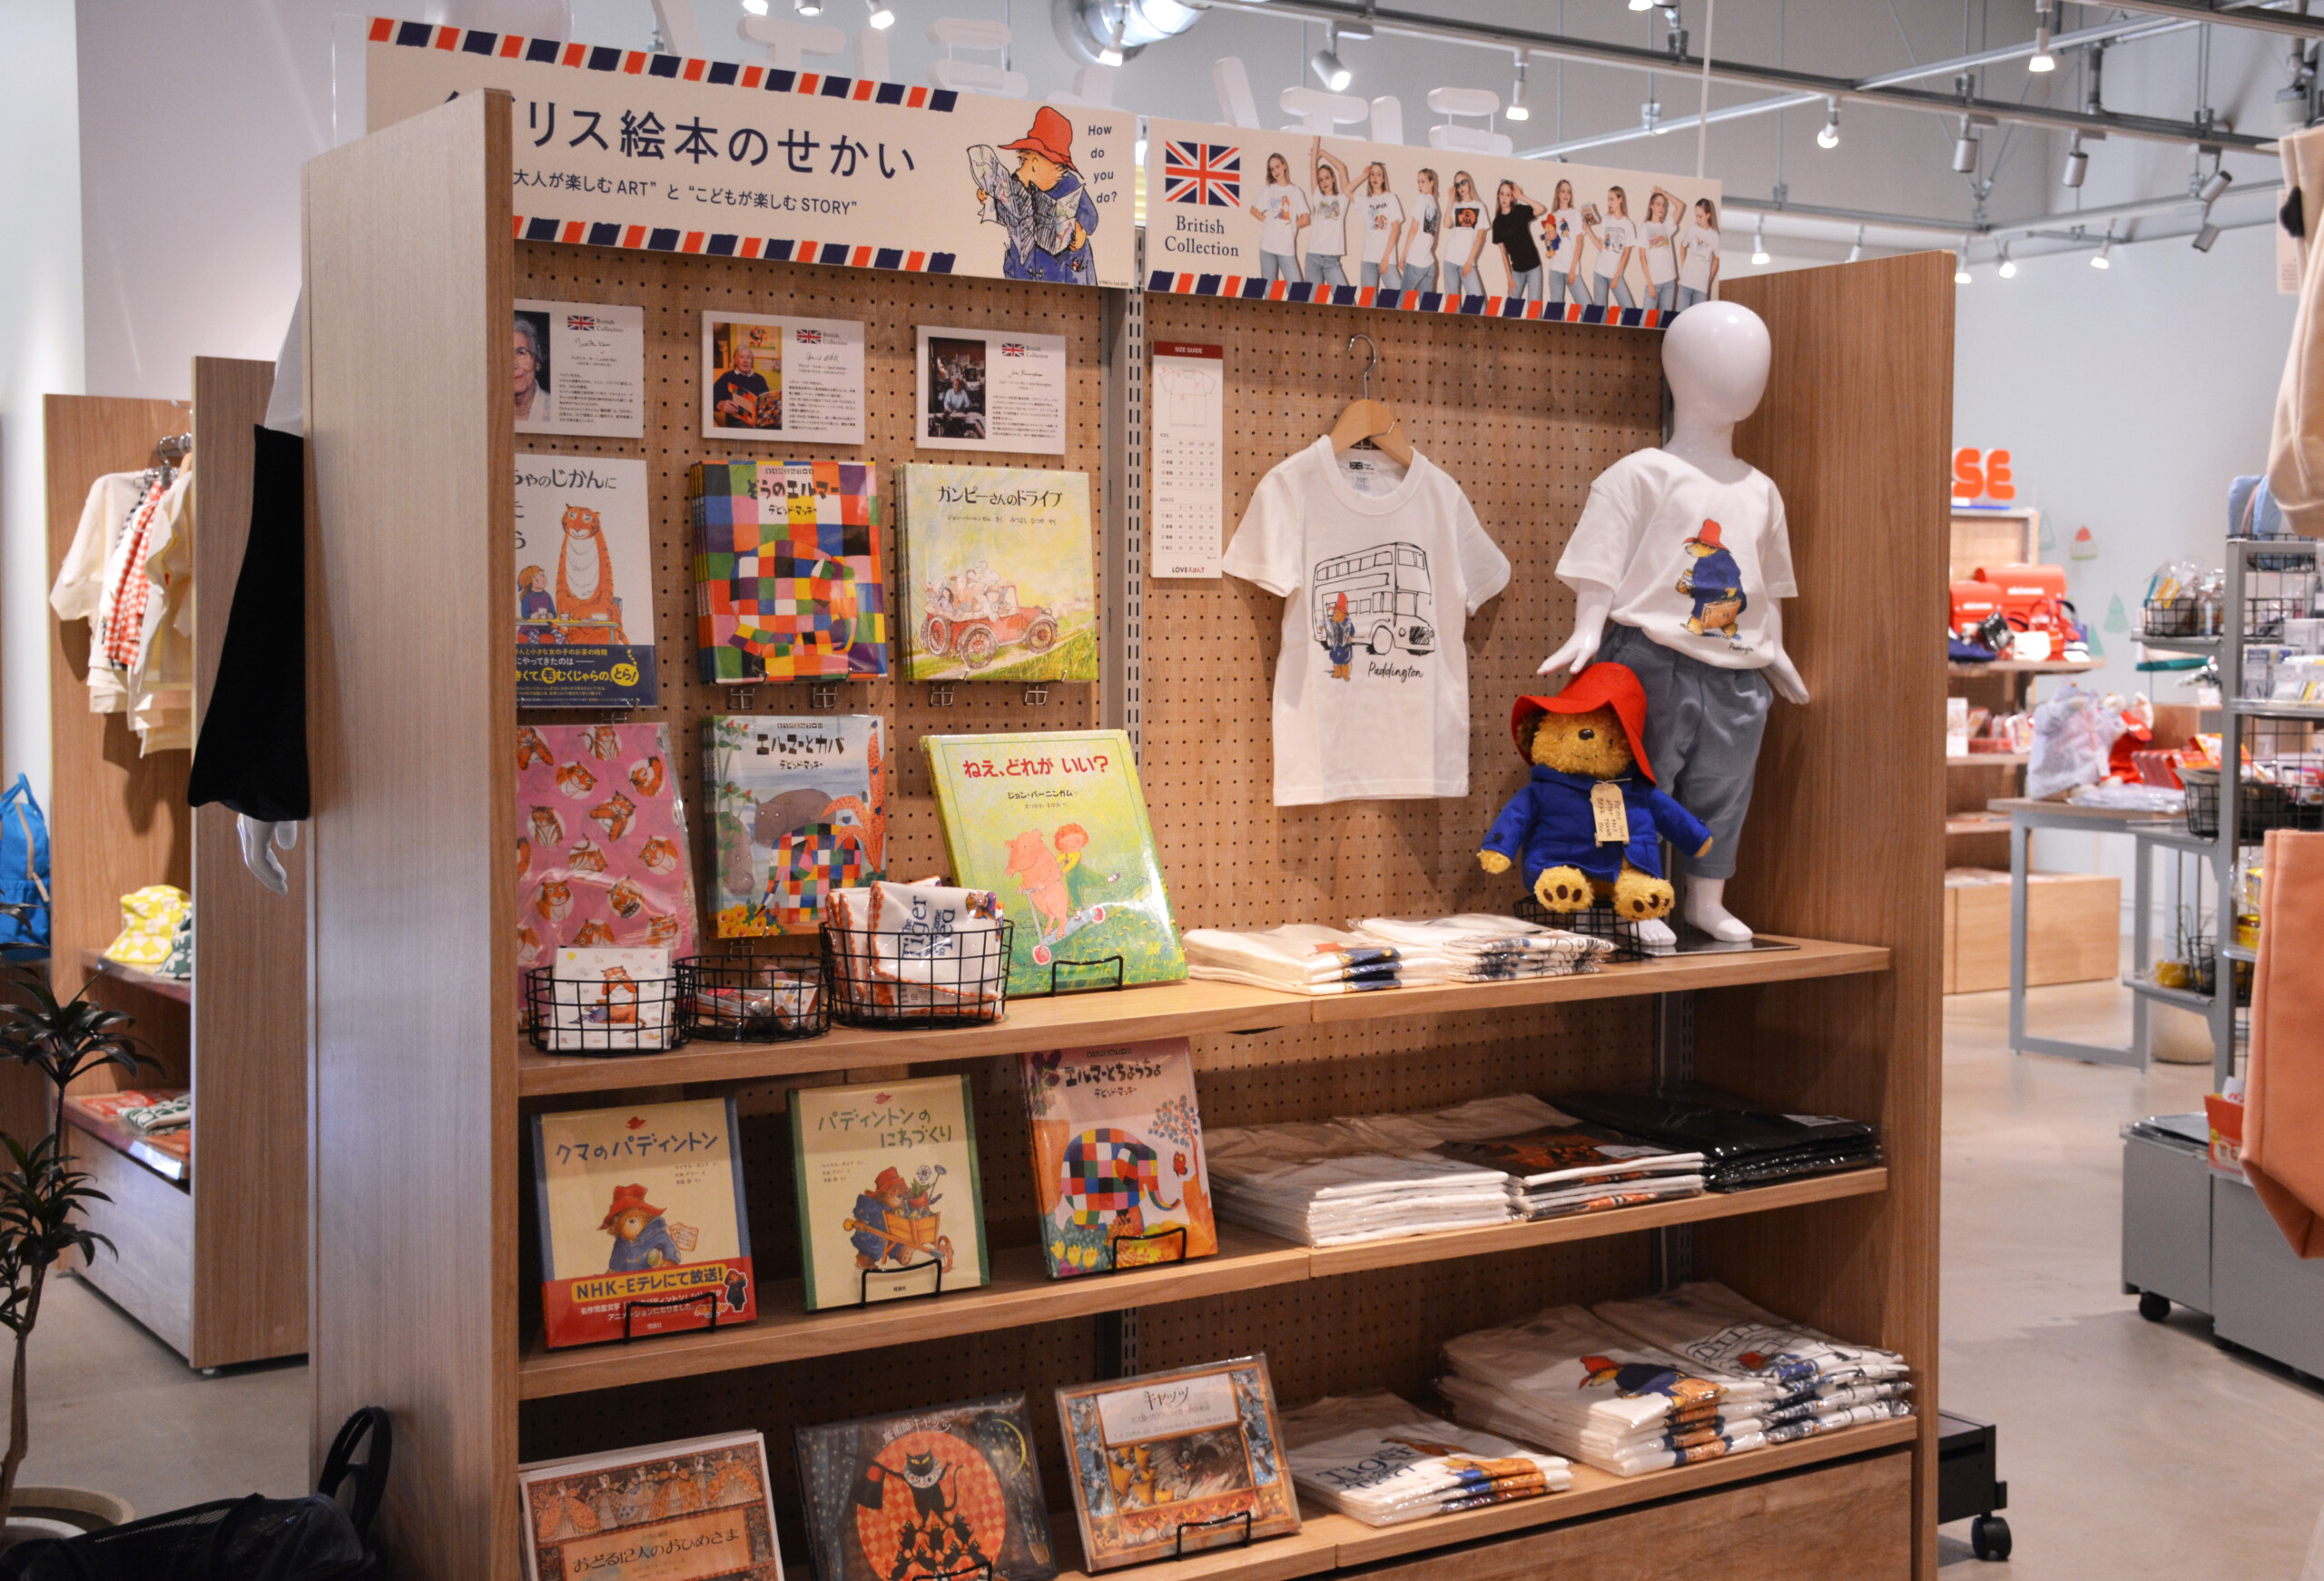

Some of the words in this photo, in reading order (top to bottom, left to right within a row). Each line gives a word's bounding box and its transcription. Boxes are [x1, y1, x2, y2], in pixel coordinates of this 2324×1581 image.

[444, 90, 915, 179] リス絵本のせかい
[1088, 125, 1112, 136] How
[1090, 148, 1105, 158] do
[1094, 171, 1114, 183] you
[1096, 192, 1118, 203] do?
[1176, 215, 1225, 234] British
[1165, 236, 1239, 257] Collection
[747, 479, 840, 500] ぞうのエルマー
[938, 485, 1063, 508] ガンピーさんのドライブ
[1368, 661, 1423, 685] Paddington
[756, 734, 845, 755] エルマーとカバ
[963, 757, 1054, 778] ねえ、どれが
[902, 895, 931, 958] Tiger
[1064, 1057, 1161, 1087] エルマーとちょうちょ
[819, 1107, 931, 1131] パディントンの
[556, 1131, 718, 1165] クマのパディントン
[881, 1125, 951, 1149] にわづくり
[1144, 1386, 1189, 1410] キャッツ
[574, 1527, 740, 1573] おどる12人のおひめさま
